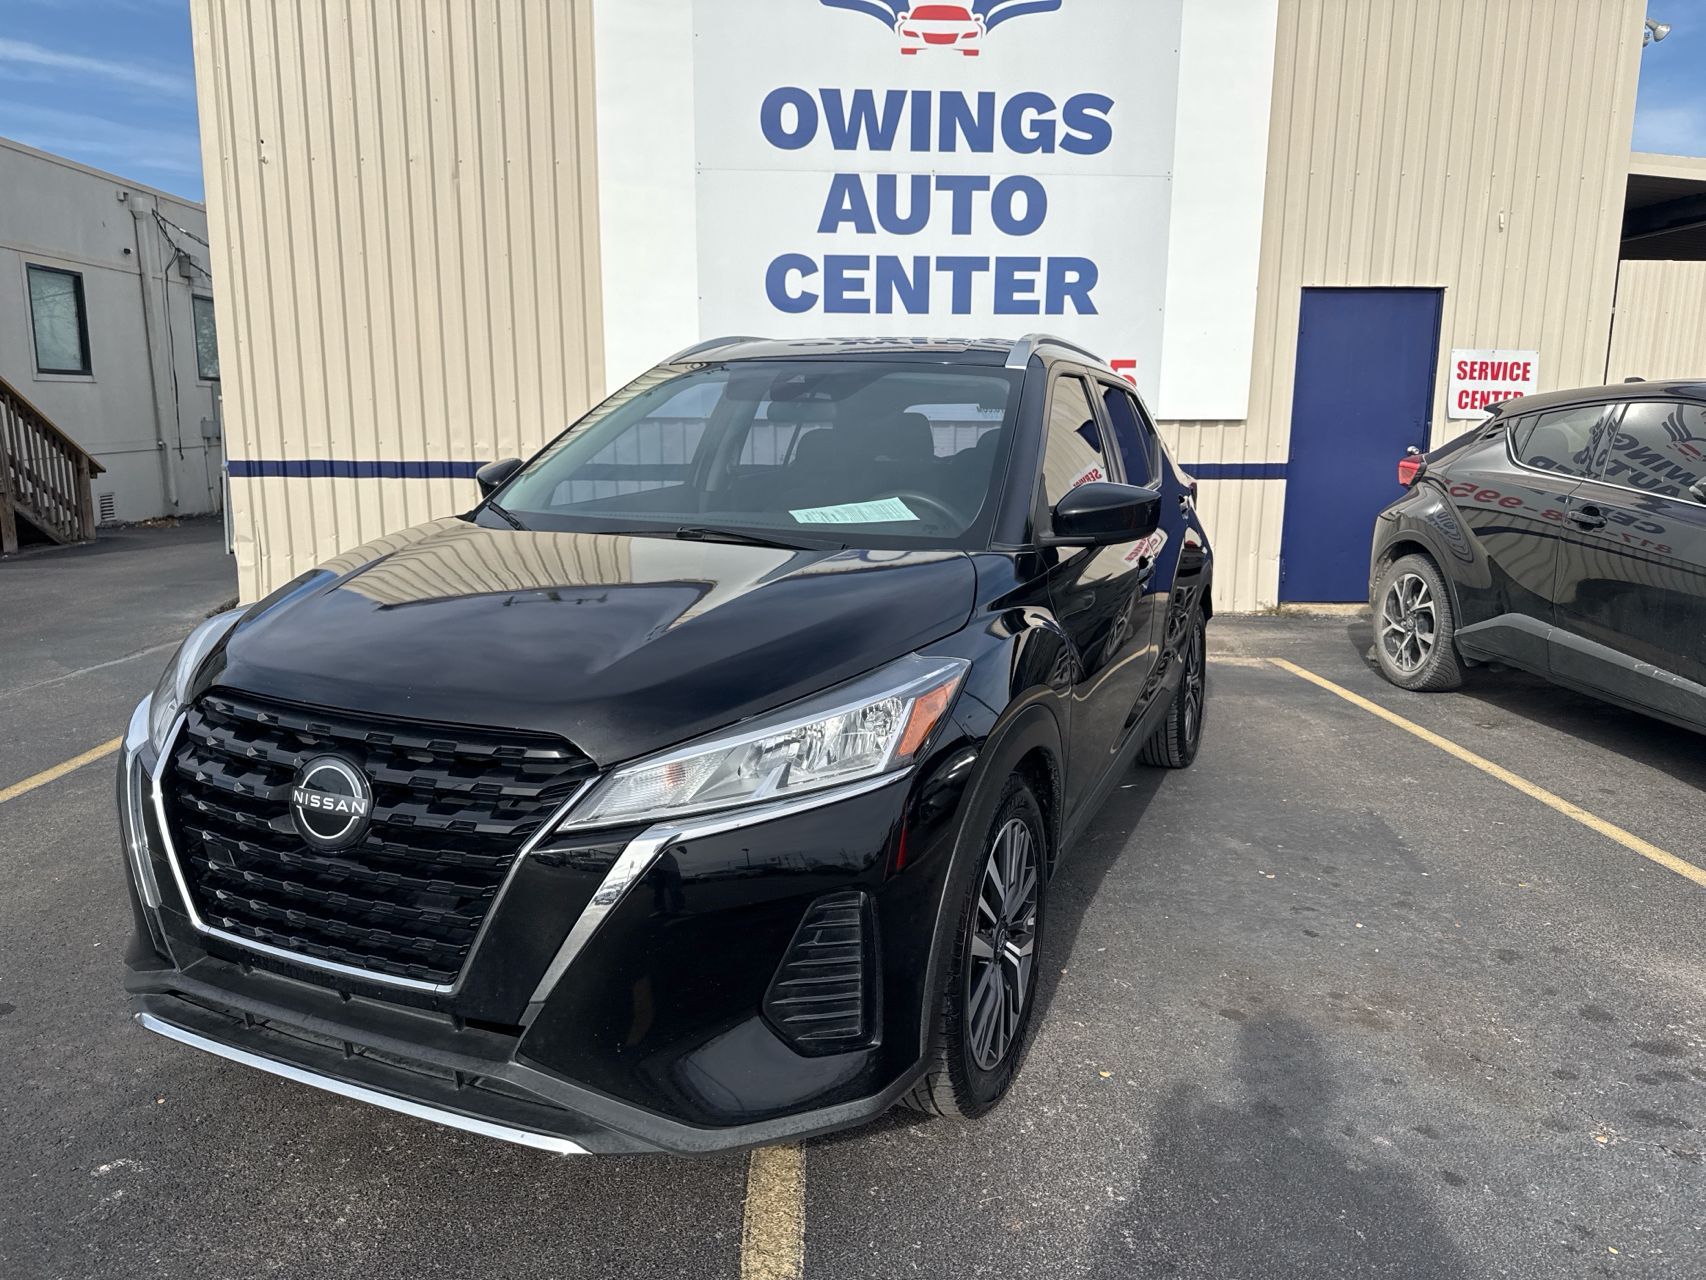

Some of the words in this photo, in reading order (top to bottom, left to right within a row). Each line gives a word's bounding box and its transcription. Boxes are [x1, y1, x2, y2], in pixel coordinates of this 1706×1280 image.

[760, 88, 1113, 155] OWINGS
[818, 173, 1046, 236] AUTO
[765, 253, 1098, 315] CENTER
[1456, 361, 1531, 382] SERVICE
[293, 790, 366, 814] NISSAN
